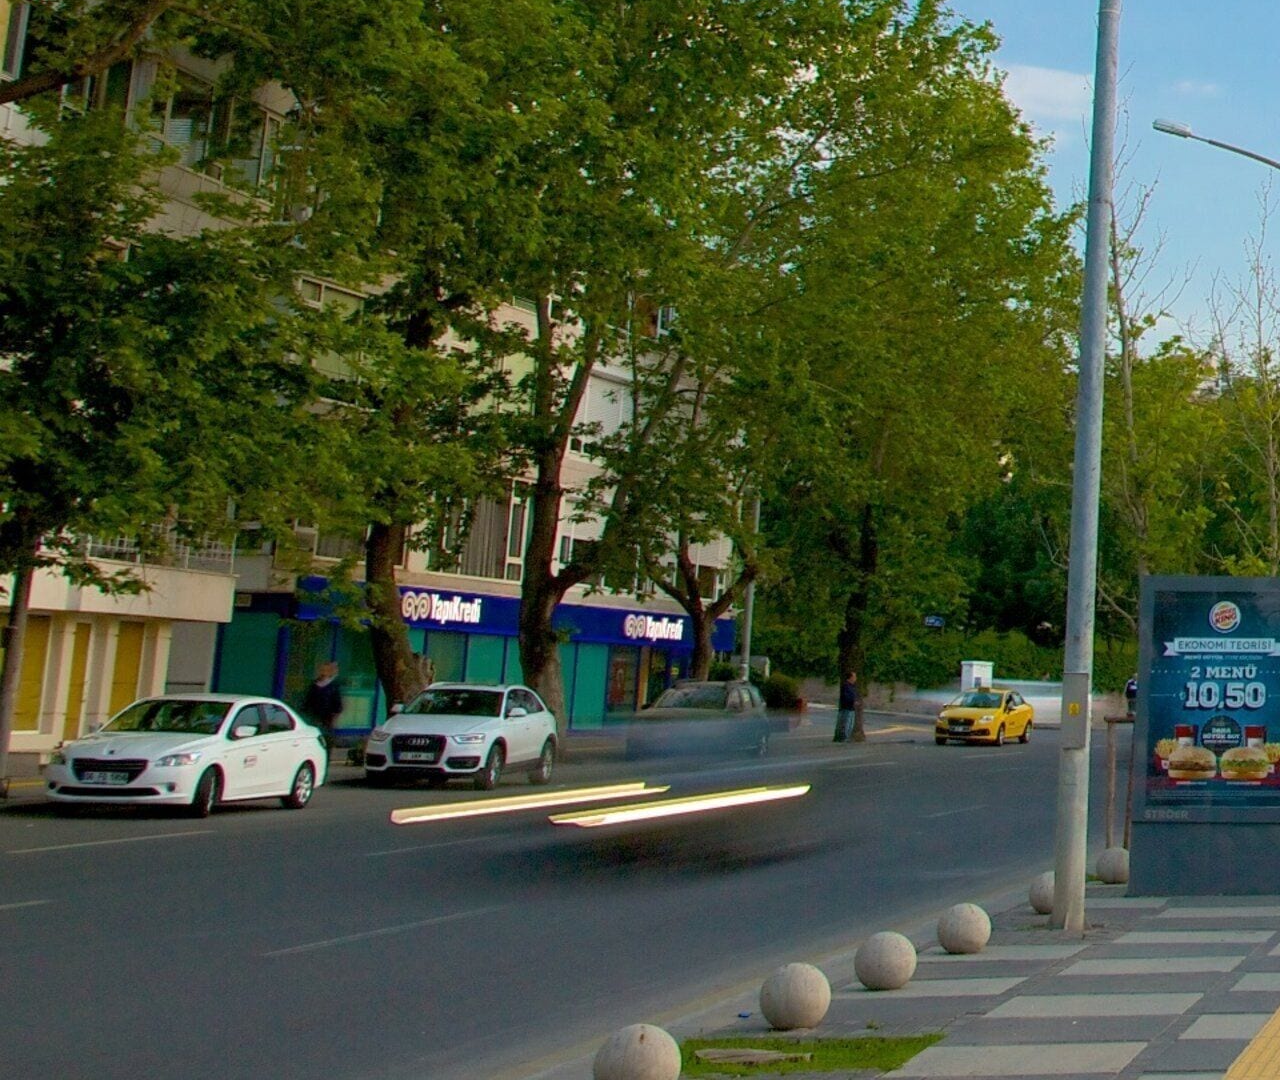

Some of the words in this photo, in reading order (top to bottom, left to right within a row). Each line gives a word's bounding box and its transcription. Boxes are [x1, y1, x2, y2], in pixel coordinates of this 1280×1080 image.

[430, 594, 482, 624] YapıKredi
[1230, 640, 1272, 650] TEORİSİ
[1191, 666, 1201, 678] 2
[1205, 664, 1257, 679] MENÜ
[1185, 681, 1266, 709] 10,50
